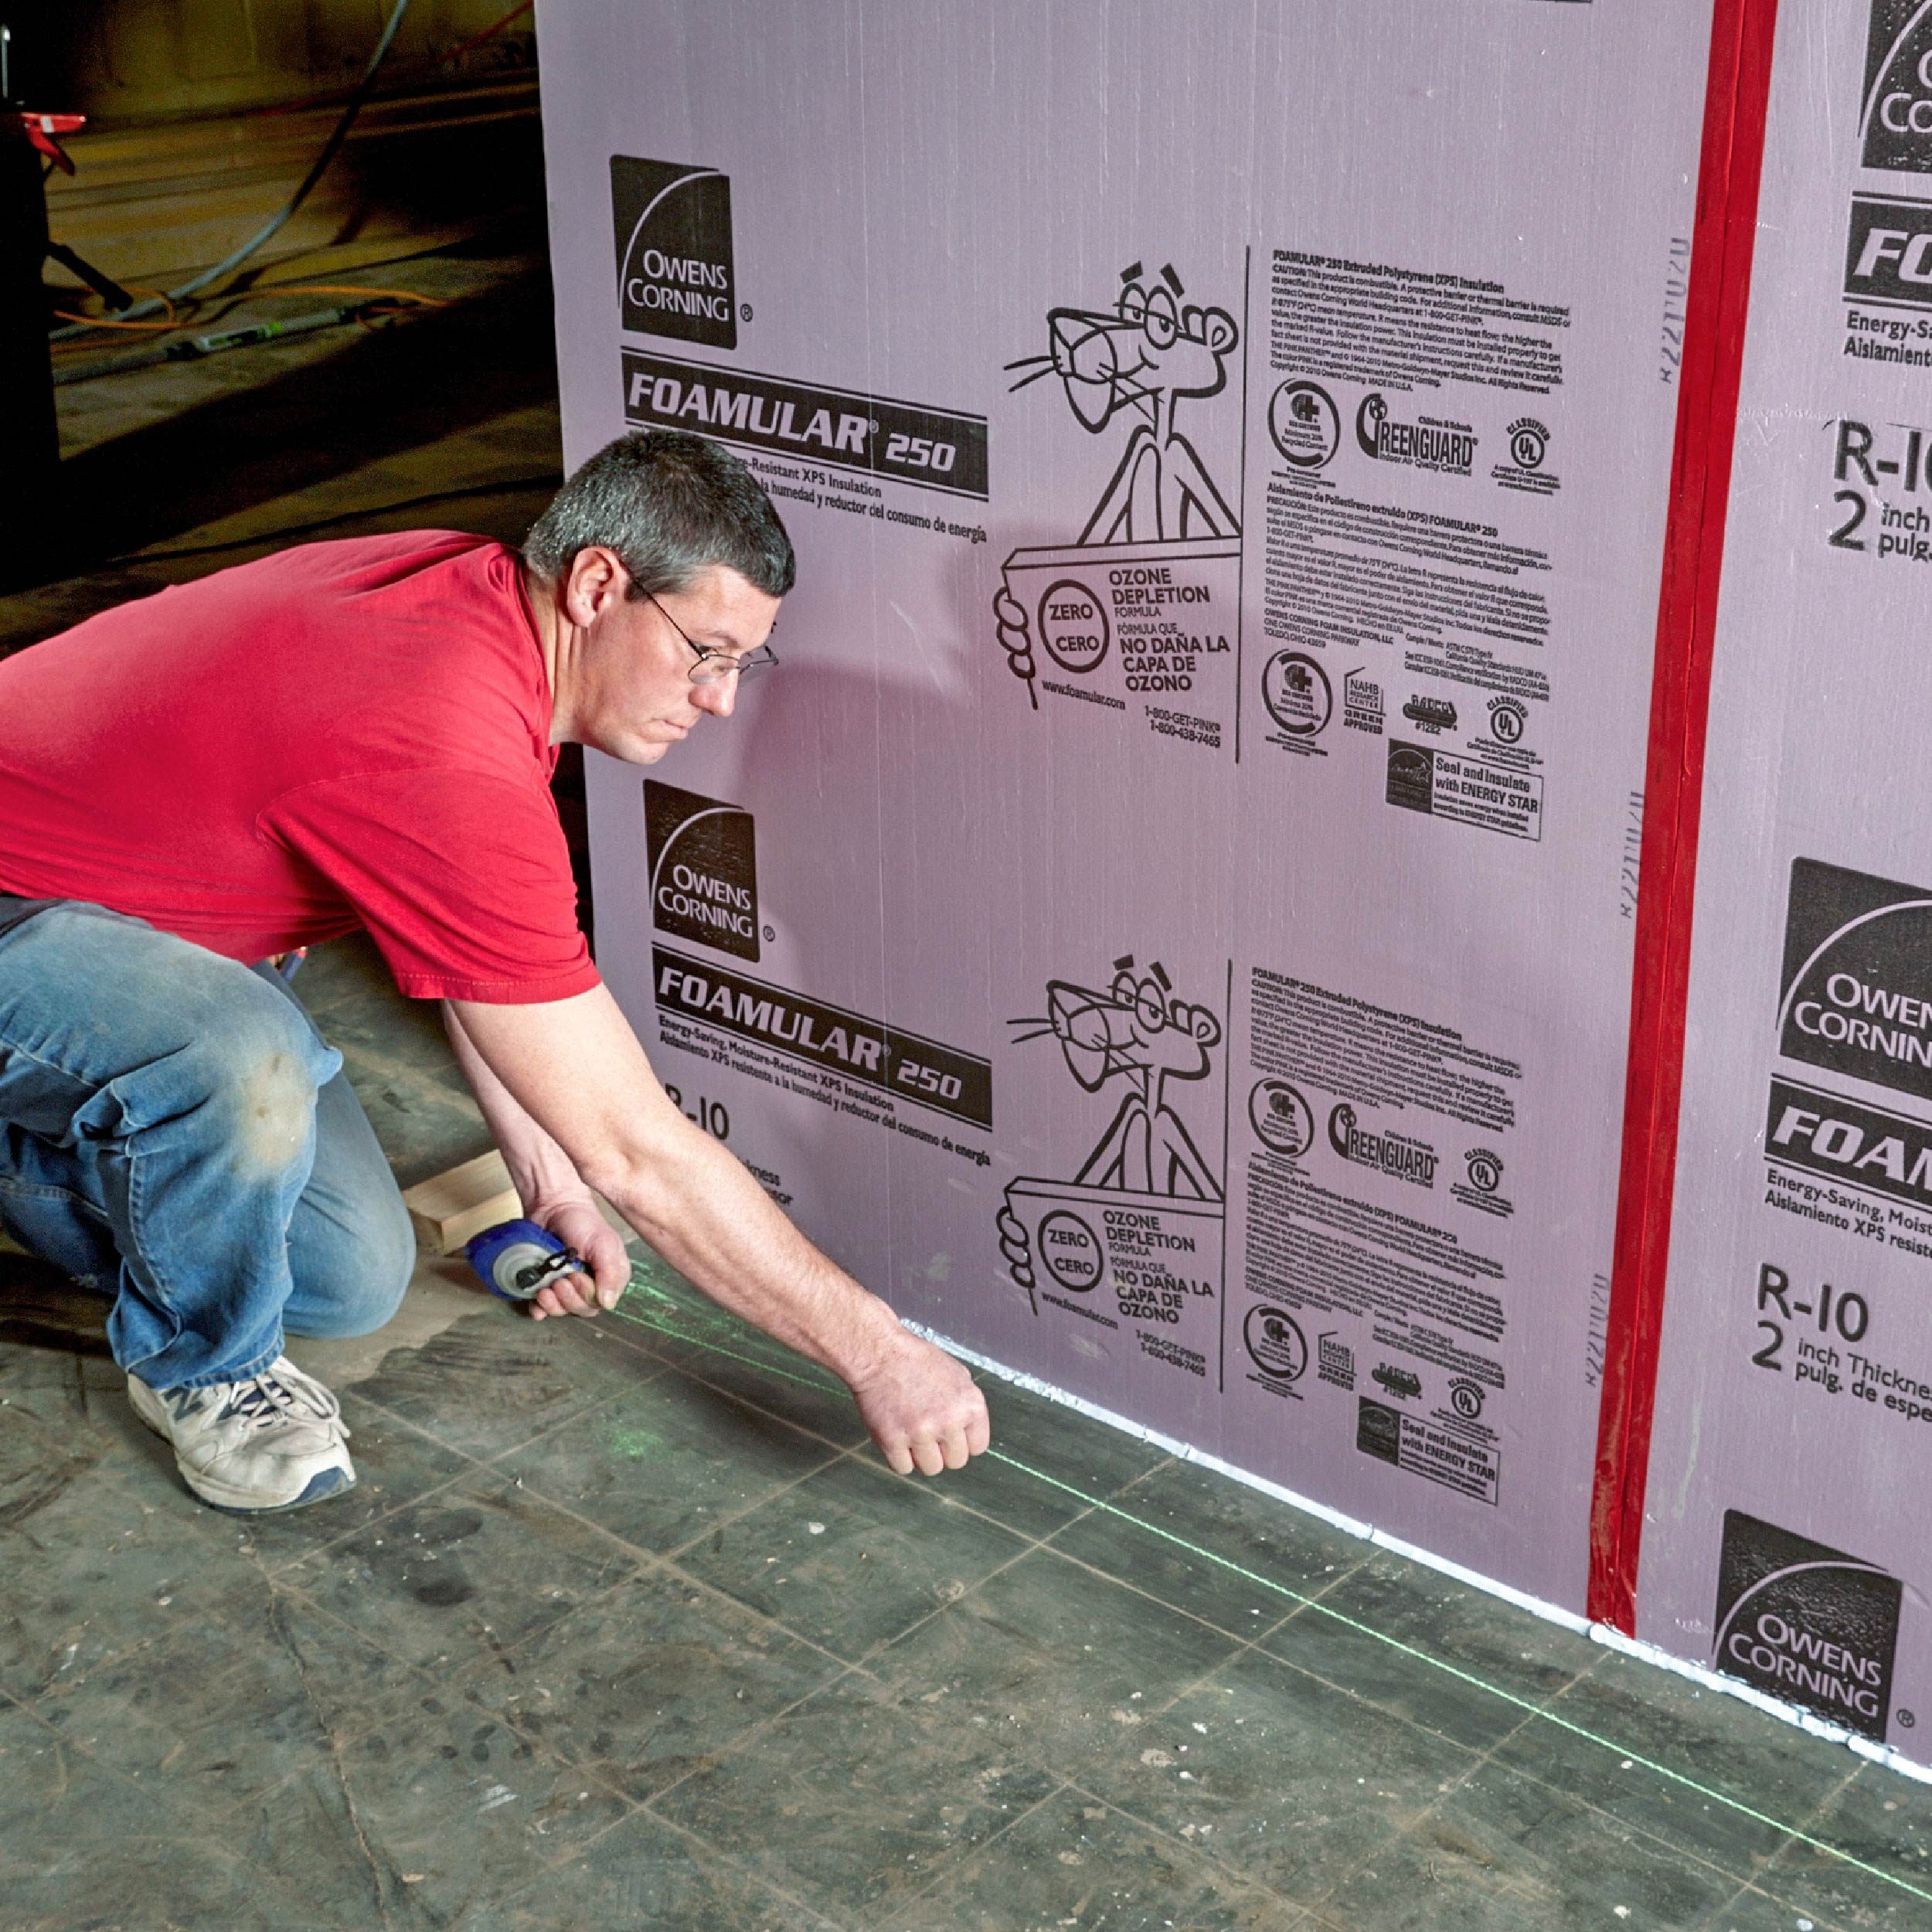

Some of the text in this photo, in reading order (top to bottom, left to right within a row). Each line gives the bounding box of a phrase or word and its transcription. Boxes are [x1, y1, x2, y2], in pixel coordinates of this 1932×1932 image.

[644, 249, 727, 291] OWENS
[628, 278, 729, 322] CORNING
[1843, 335, 1932, 368] Aislamient
[885, 431, 956, 473] 250
[1519, 436, 1536, 461] UL
[1834, 420, 1932, 492] R-1
[802, 467, 825, 485] XPS
[828, 472, 881, 498] Insulation
[770, 479, 814, 502] humedad
[816, 492, 821, 509] y
[825, 492, 866, 514] reductor
[869, 501, 883, 519] del
[886, 509, 930, 529] consumo
[934, 515, 945, 532] de
[948, 521, 987, 545] energía
[1828, 490, 1930, 551] 2 inch
[1109, 568, 1172, 586] OZONE
[1111, 586, 1210, 605] DEPLETION
[1049, 604, 1094, 621] ZERO
[1114, 607, 1162, 618] FORMULA
[1055, 635, 1100, 651] CERO
[1120, 631, 1230, 655] NO DAÑA LA
[1158, 622, 1178, 635] QUE
[1123, 656, 1196, 672] CAPA DE
[1042, 679, 1126, 710] www.foamular.com
[1125, 675, 1192, 692] OZONO
[1350, 679, 1378, 695] NAHB
[1343, 716, 1382, 735] APPROVED
[1344, 708, 1382, 726] GREEN
[1498, 716, 1514, 737] UL
[1436, 756, 1529, 794] Seal and Insulate
[1435, 775, 1459, 792] with
[1461, 781, 1505, 805] ENERGY
[1507, 791, 1537, 813] STAR
[672, 864, 751, 910] OWENS
[658, 886, 753, 938] CORNING
[660, 1029, 709, 1060] Aislamiento
[710, 1047, 729, 1067] XPS
[732, 1058, 772, 1083] resistente
[775, 1075, 780, 1087] a
[782, 1074, 789, 1090] la
[792, 1079, 832, 1106] humedad
[833, 1097, 838, 1113] y
[841, 1098, 879, 1124] reductor
[882, 1112, 896, 1130] del
[899, 1122, 938, 1146] consumo
[942, 1134, 953, 1151] de
[729, 1039, 818, 1084] Moisture-Resistant
[820, 1073, 840, 1092] XPS
[845, 1083, 894, 1113] Insulation
[896, 1059, 962, 1100] 250
[1475, 1163, 1491, 1185] UL
[1767, 1168, 1884, 1223] Energy-Saving,
[1103, 1209, 1161, 1231] OZONE
[1764, 1189, 1850, 1230] Aislamiento
[1853, 1219, 1885, 1243] XPS
[1048, 1228, 1089, 1248] ZERO
[1106, 1226, 1196, 1253] DEPLETION
[1108, 1241, 1151, 1257] FORMULA
[1054, 1257, 1094, 1276] CERO
[1113, 1269, 1215, 1298] NO DAÑA LA
[1116, 1286, 1183, 1308] CAPA DE
[1118, 1302, 1179, 1325] OZONO
[1757, 1263, 1869, 1342] R-10
[1752, 1320, 1932, 1402] 2 inch Thickne
[1795, 1362, 1843, 1394] pulg.
[1852, 1380, 1877, 1403] de
[1402, 1417, 1424, 1437] Seal
[1426, 1429, 1445, 1447] and
[1447, 1435, 1487, 1463] Insulate
[1402, 1435, 1423, 1452] with
[1424, 1441, 1466, 1470] ENERGY
[1468, 1459, 1495, 1481] STAR
[1757, 1614, 1882, 1686] OWENS
[1728, 1633, 1879, 1717] CORNING
